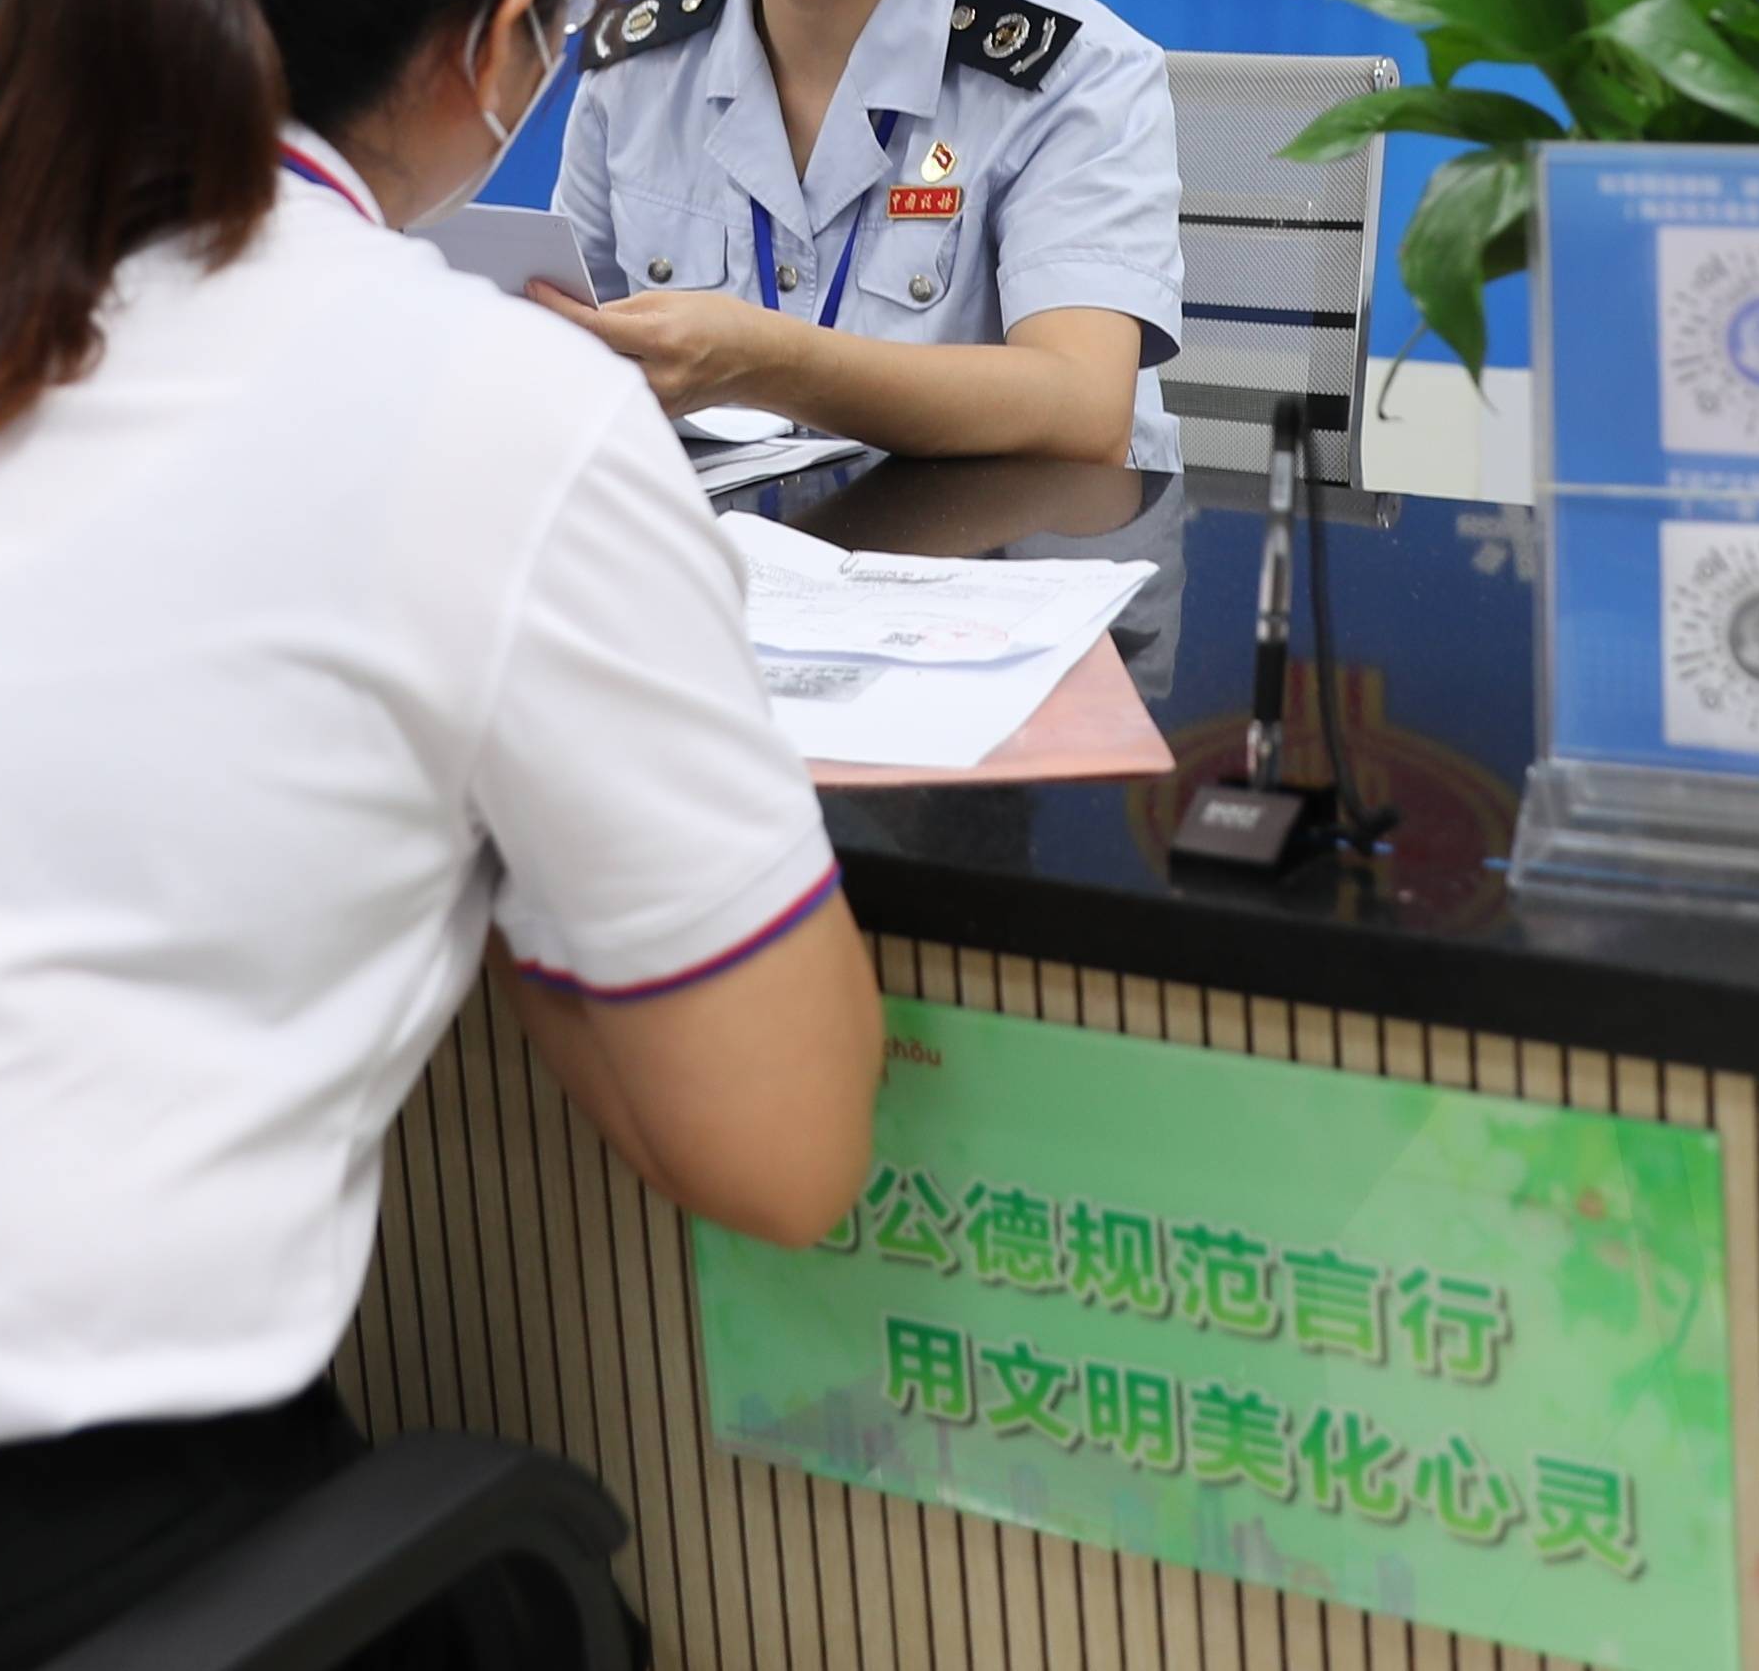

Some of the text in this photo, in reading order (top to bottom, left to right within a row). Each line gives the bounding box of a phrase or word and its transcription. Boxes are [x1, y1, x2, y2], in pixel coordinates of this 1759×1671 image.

[816, 1165, 1510, 1384] 公德规范言行
[882, 1313, 1644, 1577] 用文明美化心灵
